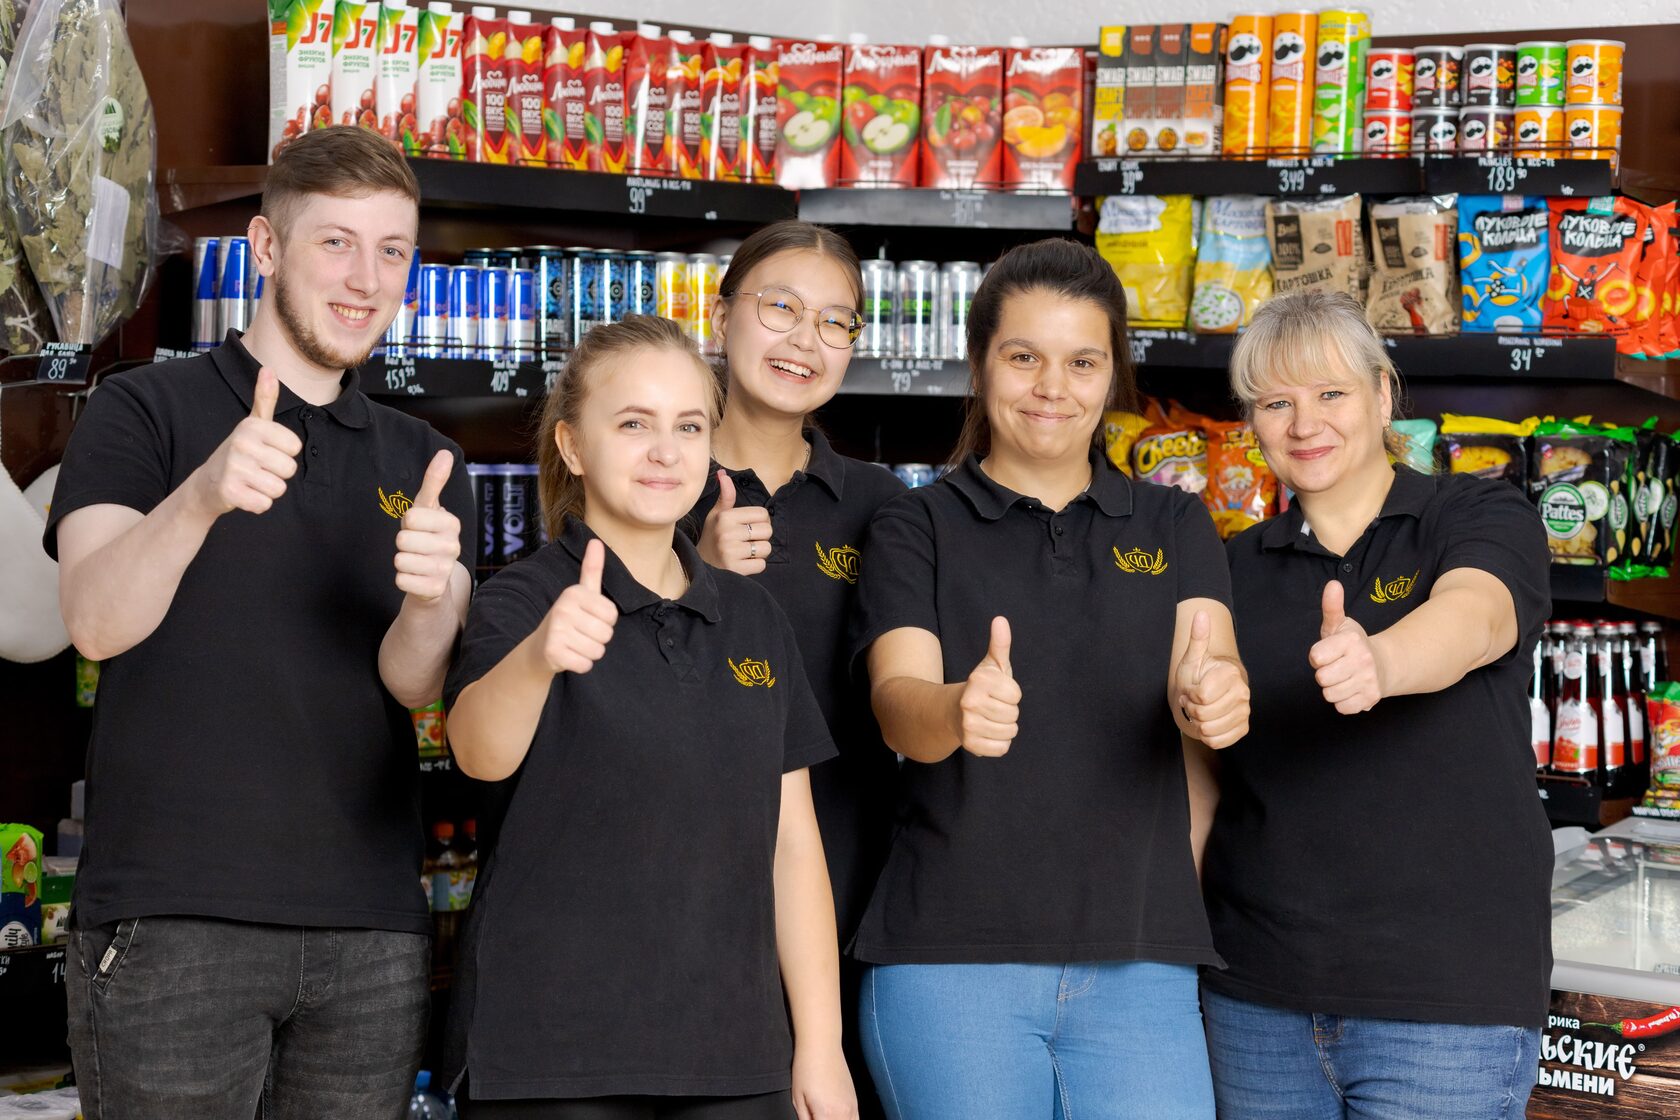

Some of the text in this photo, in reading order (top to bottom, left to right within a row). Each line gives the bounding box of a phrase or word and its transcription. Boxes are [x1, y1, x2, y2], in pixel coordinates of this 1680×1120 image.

[485, 93, 504, 106] 100
[521, 97, 541, 110] 100
[1278, 169, 1305, 193] 349
[1487, 167, 1517, 192] 189
[628, 187, 646, 214] 99
[1475, 212, 1549, 232] ЛУКОВЫЕ
[1483, 228, 1536, 247] КОЛЬЦА
[1564, 231, 1623, 249] КОЛЬЦА
[46, 342, 84, 352] РУКАВИЦА
[48, 358, 67, 380] 89
[1510, 348, 1535, 371] 34
[385, 367, 406, 390] 159
[490, 370, 509, 393] 109
[891, 370, 912, 393] 79
[1541, 503, 1585, 521] Pattes
